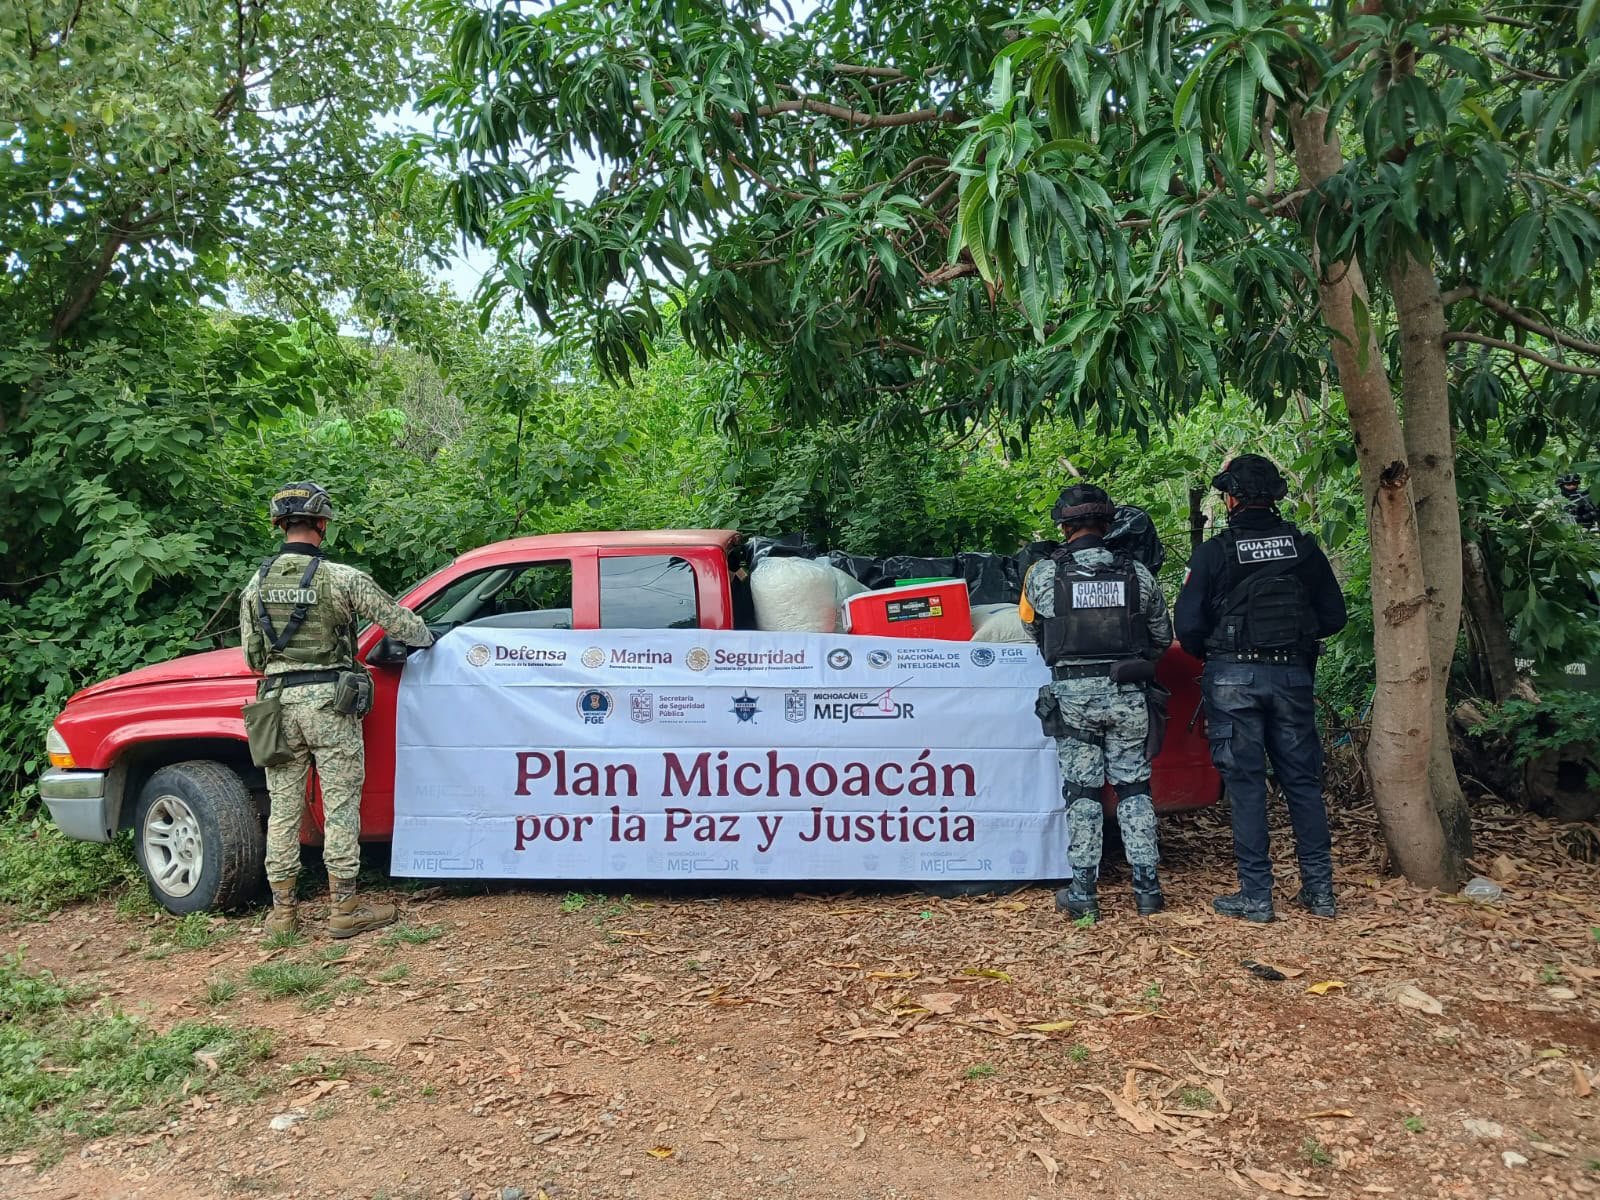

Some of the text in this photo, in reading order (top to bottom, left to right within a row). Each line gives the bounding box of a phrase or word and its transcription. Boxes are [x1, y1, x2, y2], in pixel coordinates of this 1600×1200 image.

[1239, 539, 1293, 551] GUARDIA
[1252, 549, 1284, 560] CIVIL
[1077, 582, 1119, 595] GUARDIA
[261, 588, 317, 604] EJERCITO
[1076, 594, 1122, 608] NACIONAL
[495, 645, 567, 661] Defensa
[610, 648, 672, 664] Marina
[714, 648, 805, 667] Seguridad
[897, 653, 945, 661] NACIONAL
[1001, 648, 1024, 657] FGR
[897, 662, 961, 670] INTELIGENCIA
[813, 692, 868, 700] MICHOACÁN ES
[669, 702, 705, 711] Seguridad
[584, 716, 605, 725] FGE
[514, 749, 977, 797] Plan Michoacán
[514, 805, 976, 852] por la Paz y Justicia
